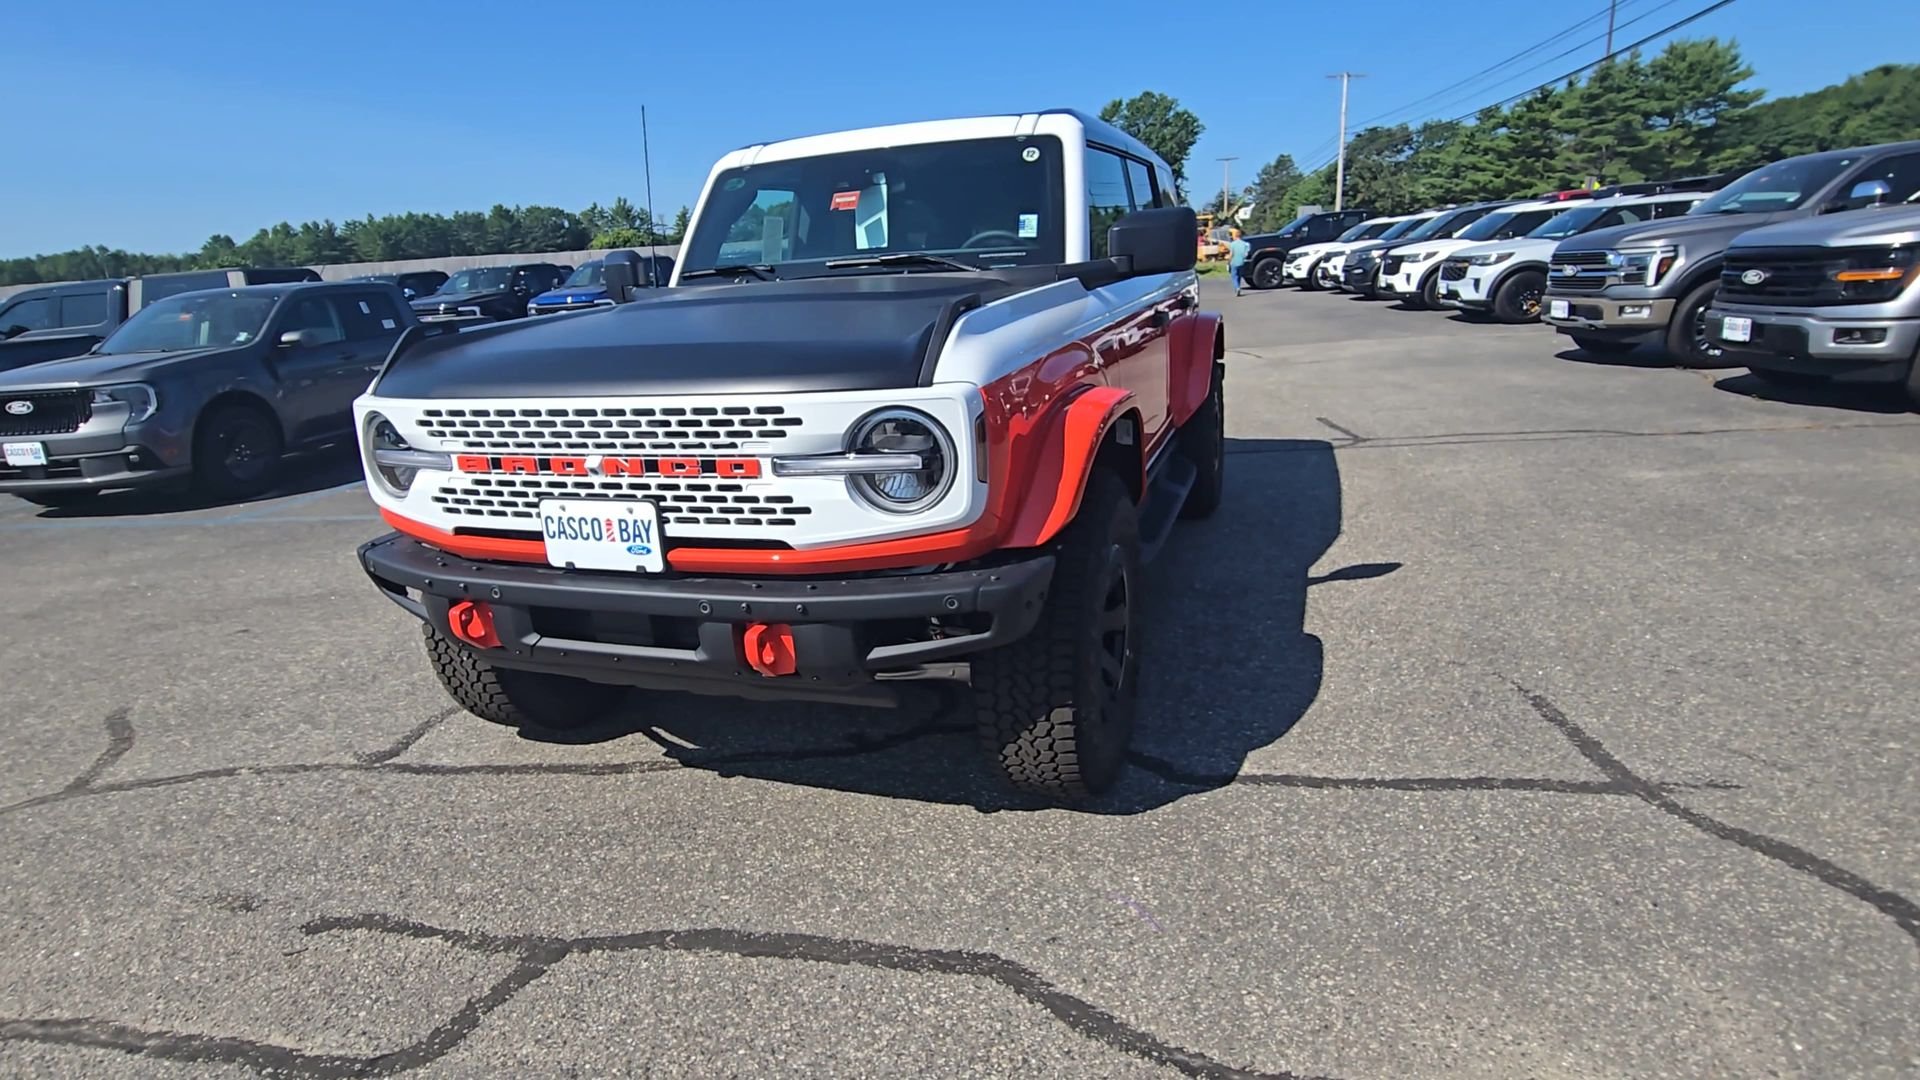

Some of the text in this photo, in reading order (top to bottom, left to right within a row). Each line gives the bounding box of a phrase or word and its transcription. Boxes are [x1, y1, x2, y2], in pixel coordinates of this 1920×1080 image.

[457, 453, 761, 479] BRONCO
[544, 515, 652, 543] CASCO BAY
[627, 545, 651, 555] Ford
